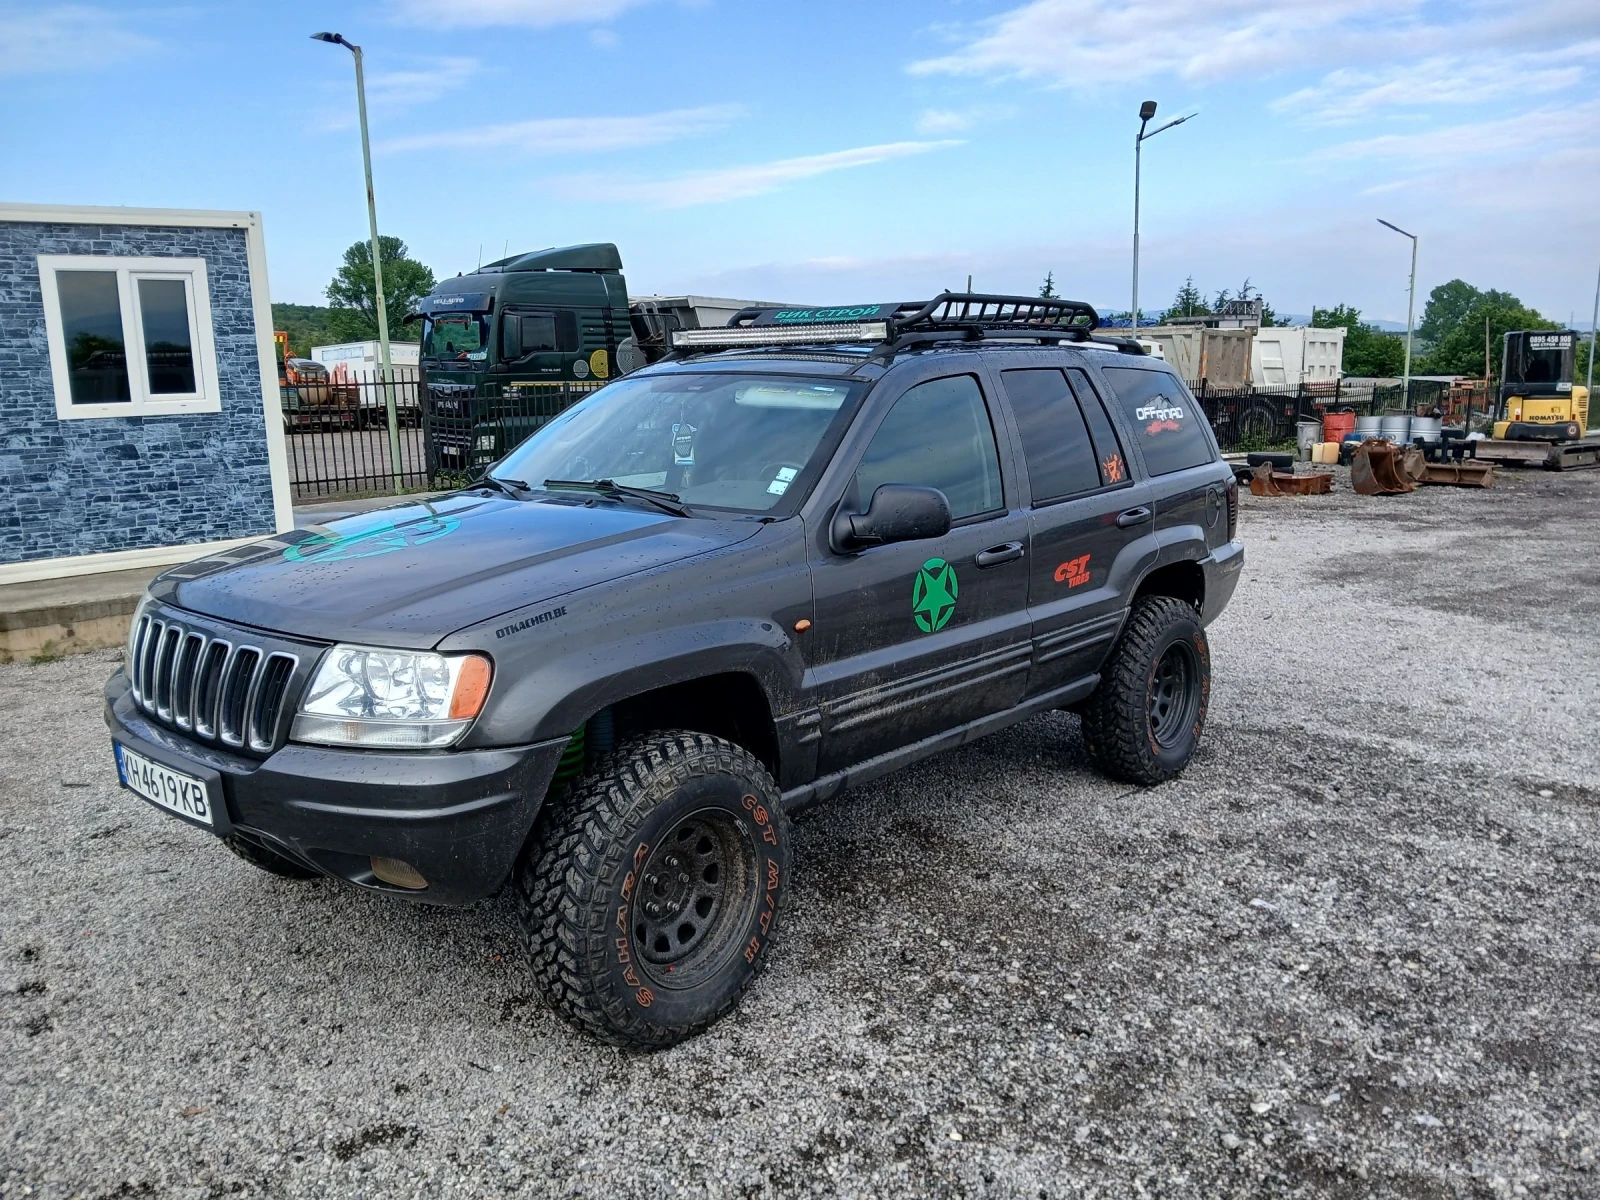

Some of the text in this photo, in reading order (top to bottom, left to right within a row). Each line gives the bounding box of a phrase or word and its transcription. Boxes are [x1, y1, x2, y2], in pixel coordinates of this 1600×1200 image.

[774, 305, 880, 319] БИК СТРОЙ
[1529, 335, 1546, 343] 0895
[1547, 335, 1559, 343] 458
[1054, 553, 1091, 582] CST
[1068, 571, 1090, 589] TIRES
[741, 794, 778, 846] CST
[615, 842, 654, 1008] SAHARA
